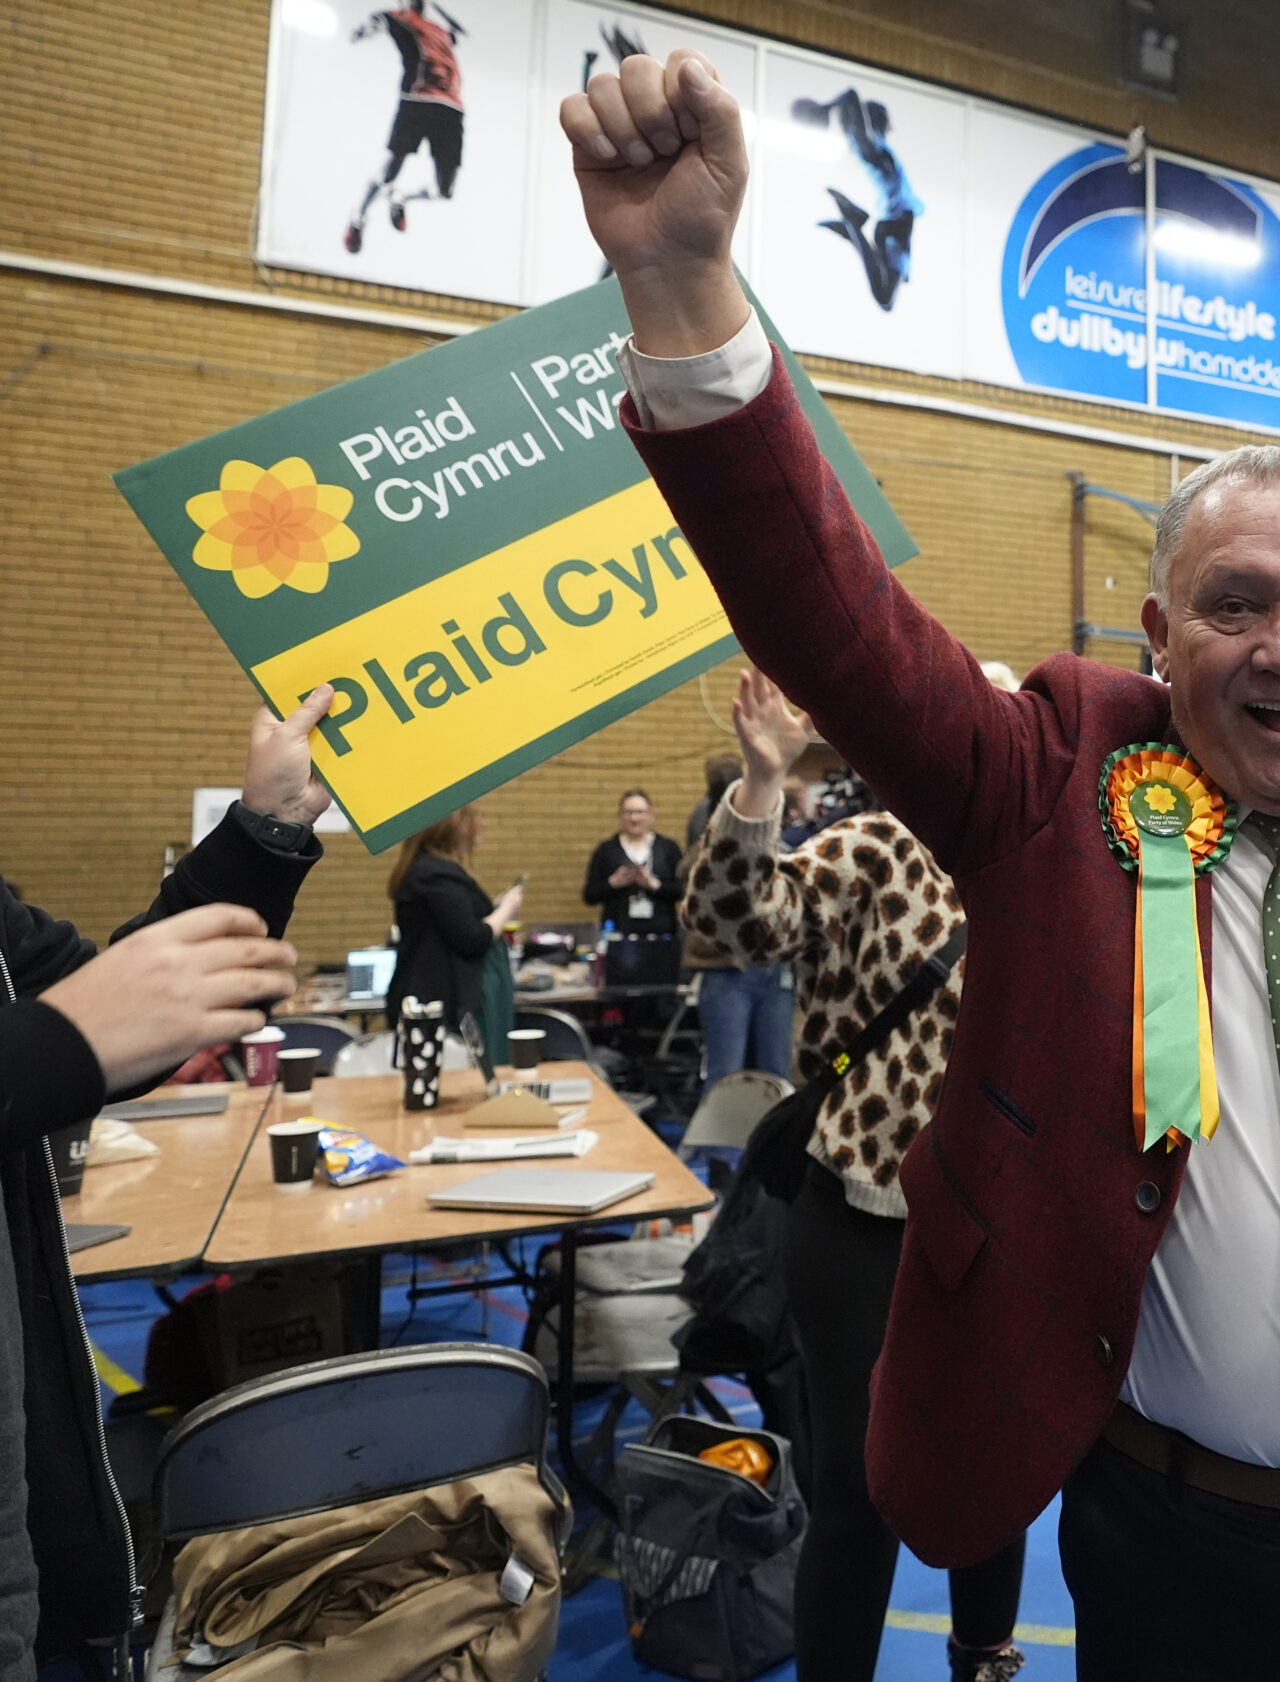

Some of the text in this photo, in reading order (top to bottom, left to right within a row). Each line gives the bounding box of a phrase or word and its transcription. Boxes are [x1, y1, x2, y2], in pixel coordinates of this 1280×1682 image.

[338, 396, 477, 481] Plaid
[374, 430, 546, 522] Cymru
[298, 593, 546, 758] Plaid
